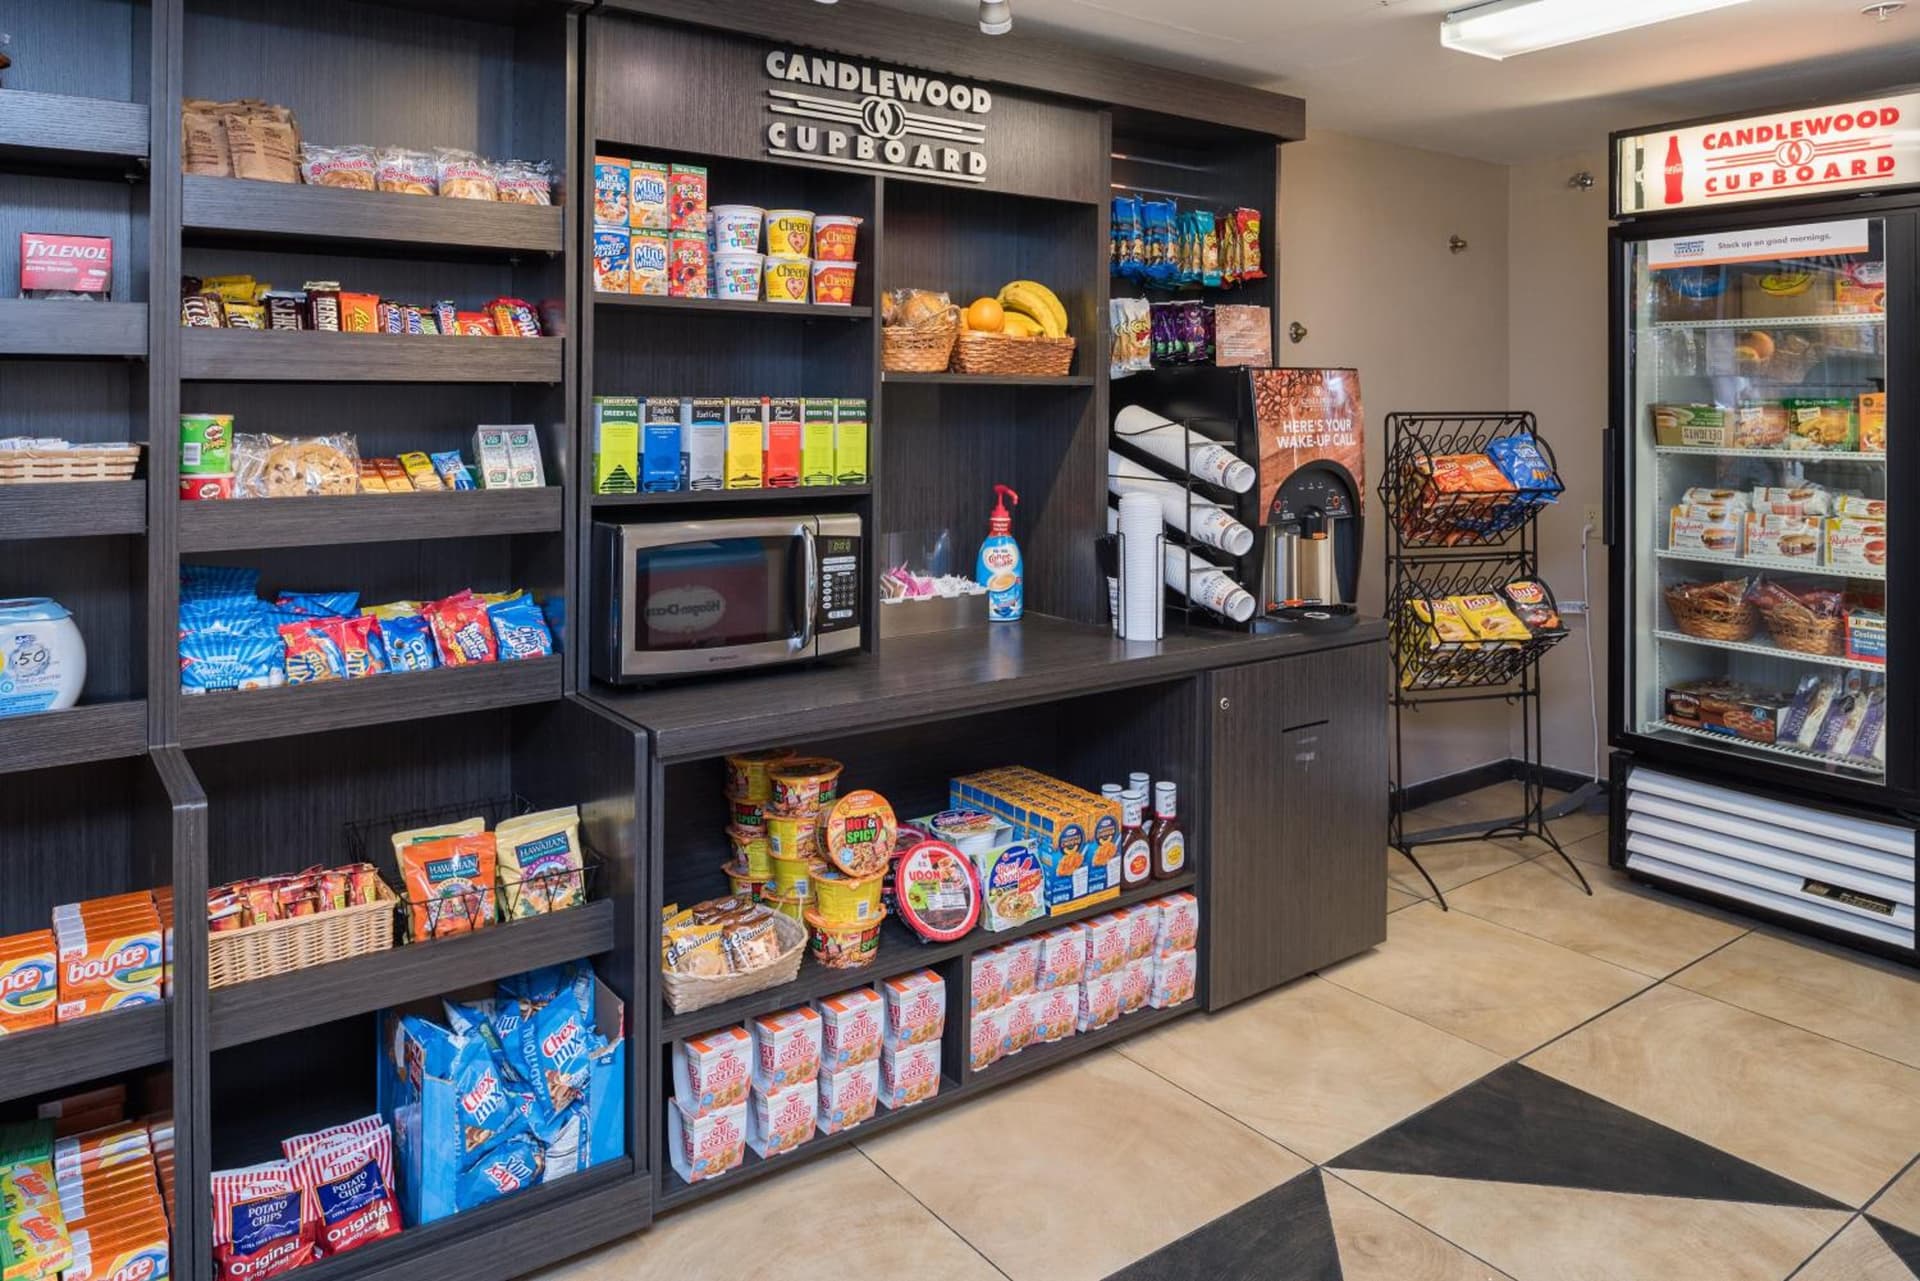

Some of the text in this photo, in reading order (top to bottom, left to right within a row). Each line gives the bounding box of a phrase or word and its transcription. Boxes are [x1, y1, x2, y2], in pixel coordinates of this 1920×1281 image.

[766, 50, 992, 113] CANDLEWOOD
[1703, 107, 1900, 151] CANDLEWOOD
[768, 121, 988, 176] CUPBOARD
[1705, 155, 1896, 192] CUPBOARD
[635, 180, 664, 196] Mini
[25, 239, 108, 260] TYLENOL
[1718, 241, 1740, 250] Stock
[1741, 241, 1752, 249] up
[1766, 236, 1788, 247] good
[1790, 232, 1832, 245] mornings.
[635, 245, 663, 261] Mini
[1283, 419, 1352, 433] HERE'S YOUR
[1276, 435, 1331, 449] WAKE-UP
[15, 649, 47, 667] .50
[205, 676, 239, 688] minis
[519, 836, 566, 858] HAWAIIAN
[847, 829, 876, 844] SPICY
[909, 870, 941, 881] UDON
[69, 946, 146, 983] bounce
[542, 1017, 577, 1058] Chex
[553, 1036, 583, 1067] mix
[463, 1068, 495, 1112] Chex
[475, 1088, 503, 1124] mix
[330, 1154, 364, 1178] Tim's
[502, 1155, 532, 1179] mix
[333, 1171, 368, 1194] POTATO
[487, 1163, 520, 1192] Chex
[250, 1184, 286, 1197] Tim's
[338, 1181, 366, 1199] CHIPS
[248, 1200, 287, 1218] POTATO
[252, 1211, 282, 1228] CHIPS
[327, 1201, 393, 1242] Original
[230, 1238, 300, 1276] Original
